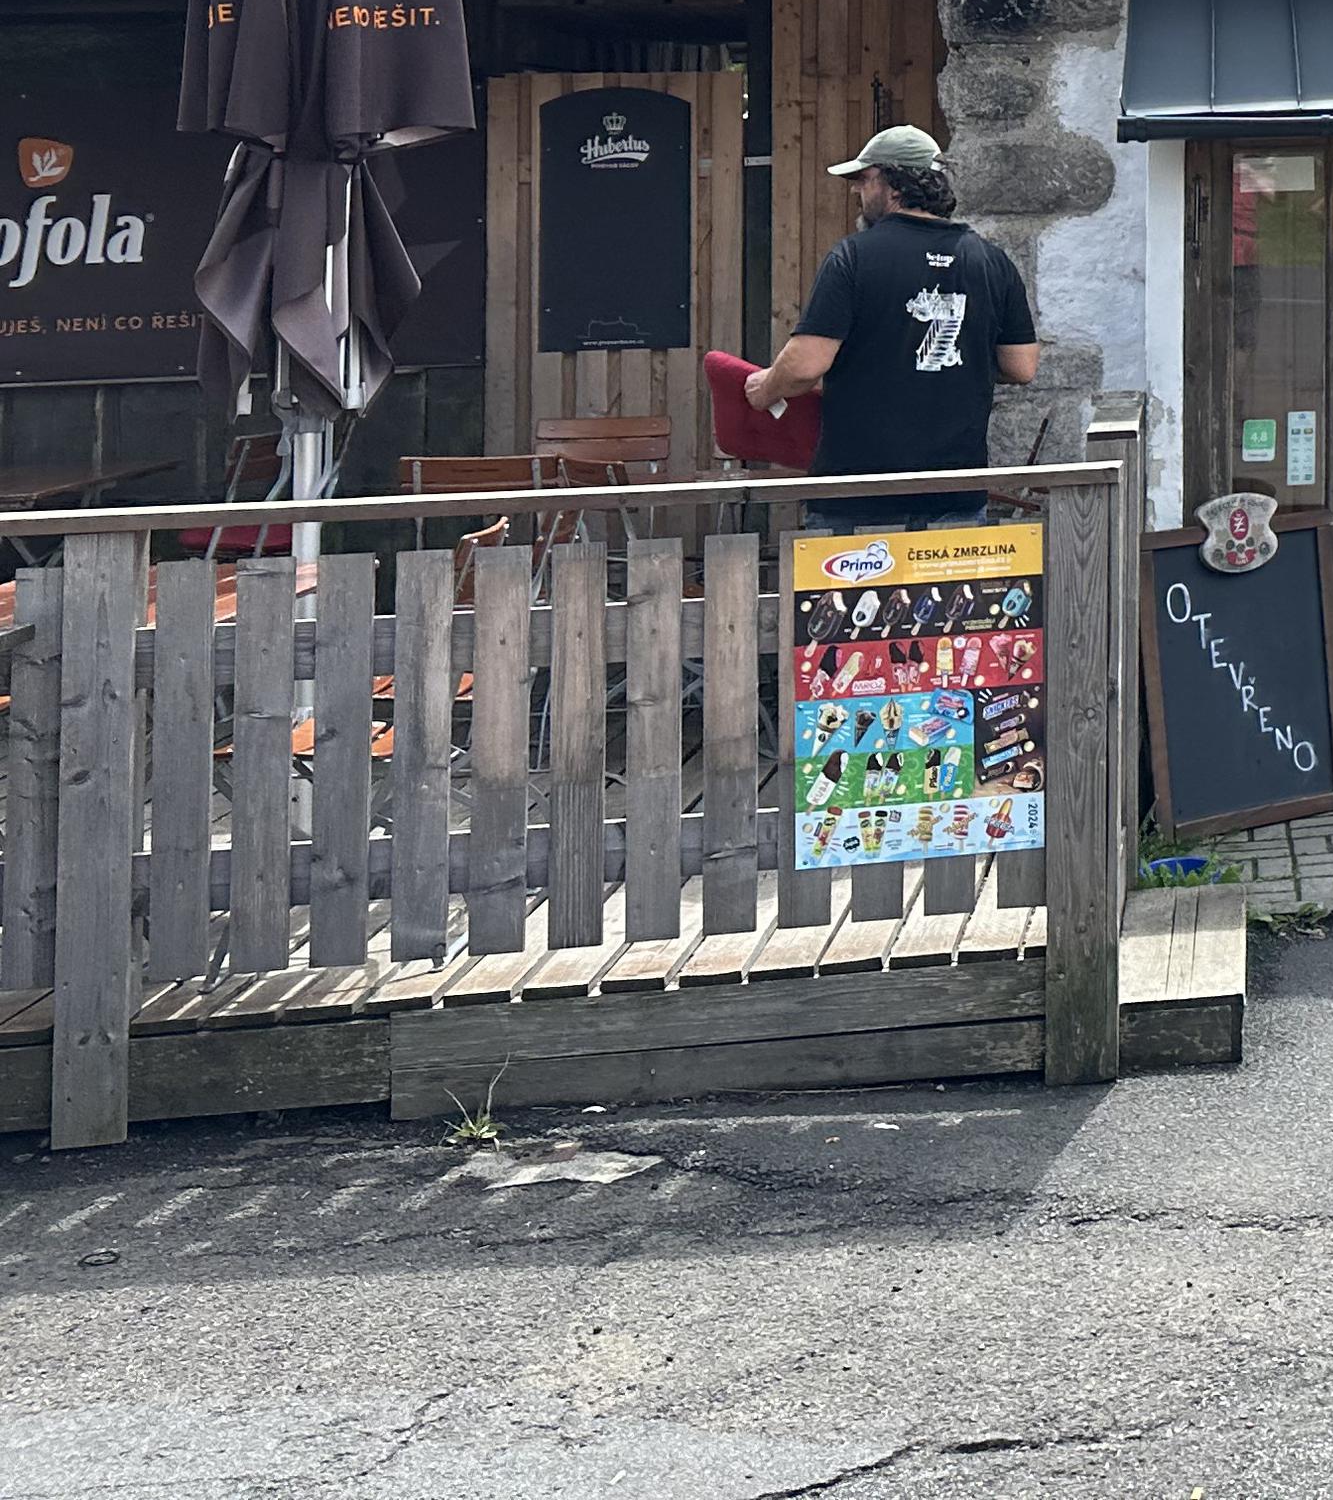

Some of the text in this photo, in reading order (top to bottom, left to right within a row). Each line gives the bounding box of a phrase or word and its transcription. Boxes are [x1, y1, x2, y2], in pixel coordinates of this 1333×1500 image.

[580, 134, 650, 161] Hubertus
[0, 194, 143, 288] ofola
[56, 314, 107, 332] NENÍ
[114, 316, 143, 331] CO
[908, 544, 1016, 560] ČESKÁ ZMRZLINA
[839, 559, 882, 573] Prima
[1166, 582, 1317, 772] OTEVŘENO
[1027, 803, 1038, 829] 2024
